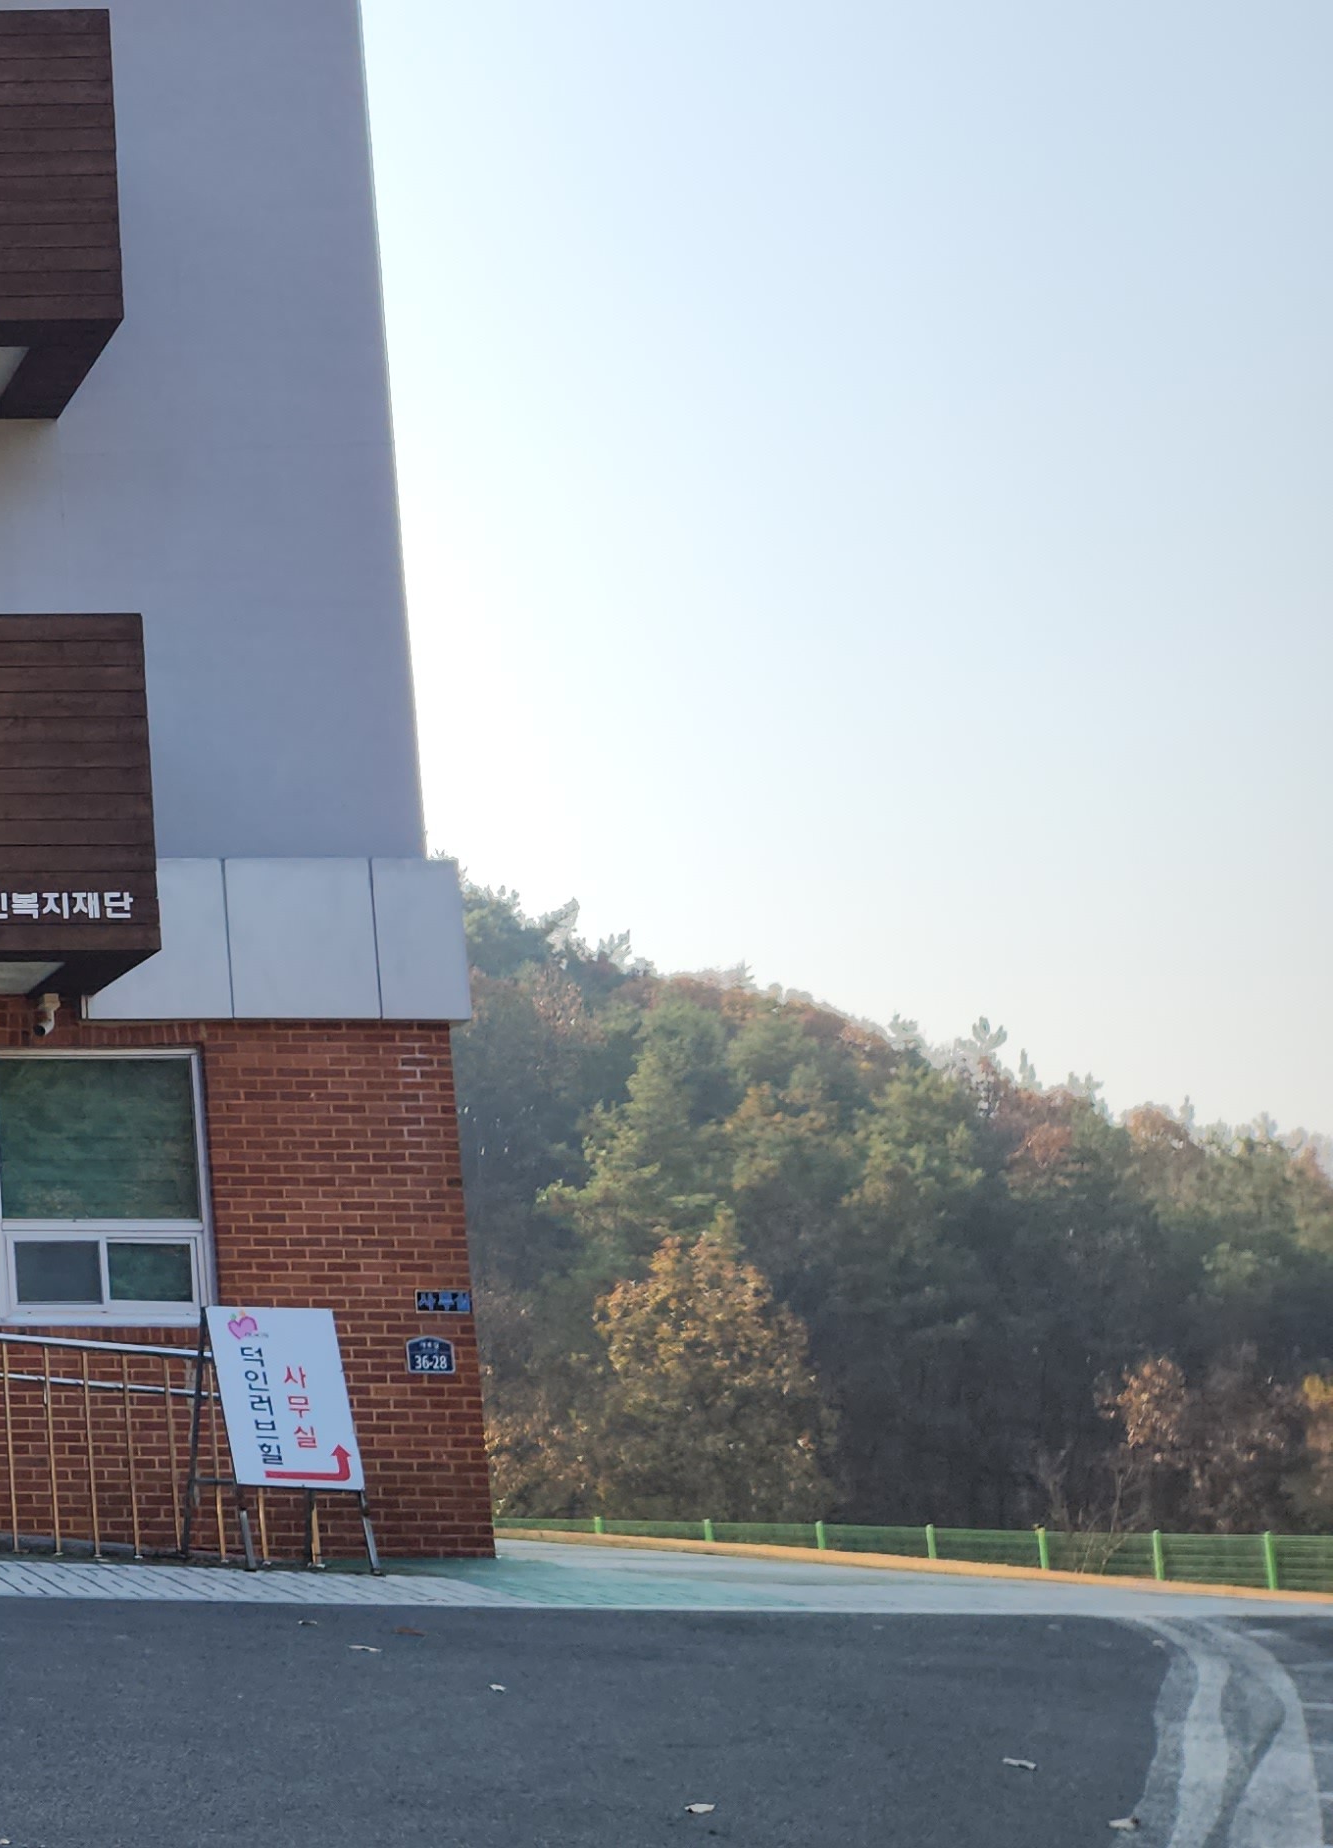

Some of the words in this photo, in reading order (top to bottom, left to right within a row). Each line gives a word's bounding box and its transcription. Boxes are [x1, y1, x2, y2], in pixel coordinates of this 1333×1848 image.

[414, 1355, 448, 1370] 36-28
[240, 1346, 284, 1466] 덕인러브힐
[284, 1365, 318, 1449] 사무실
